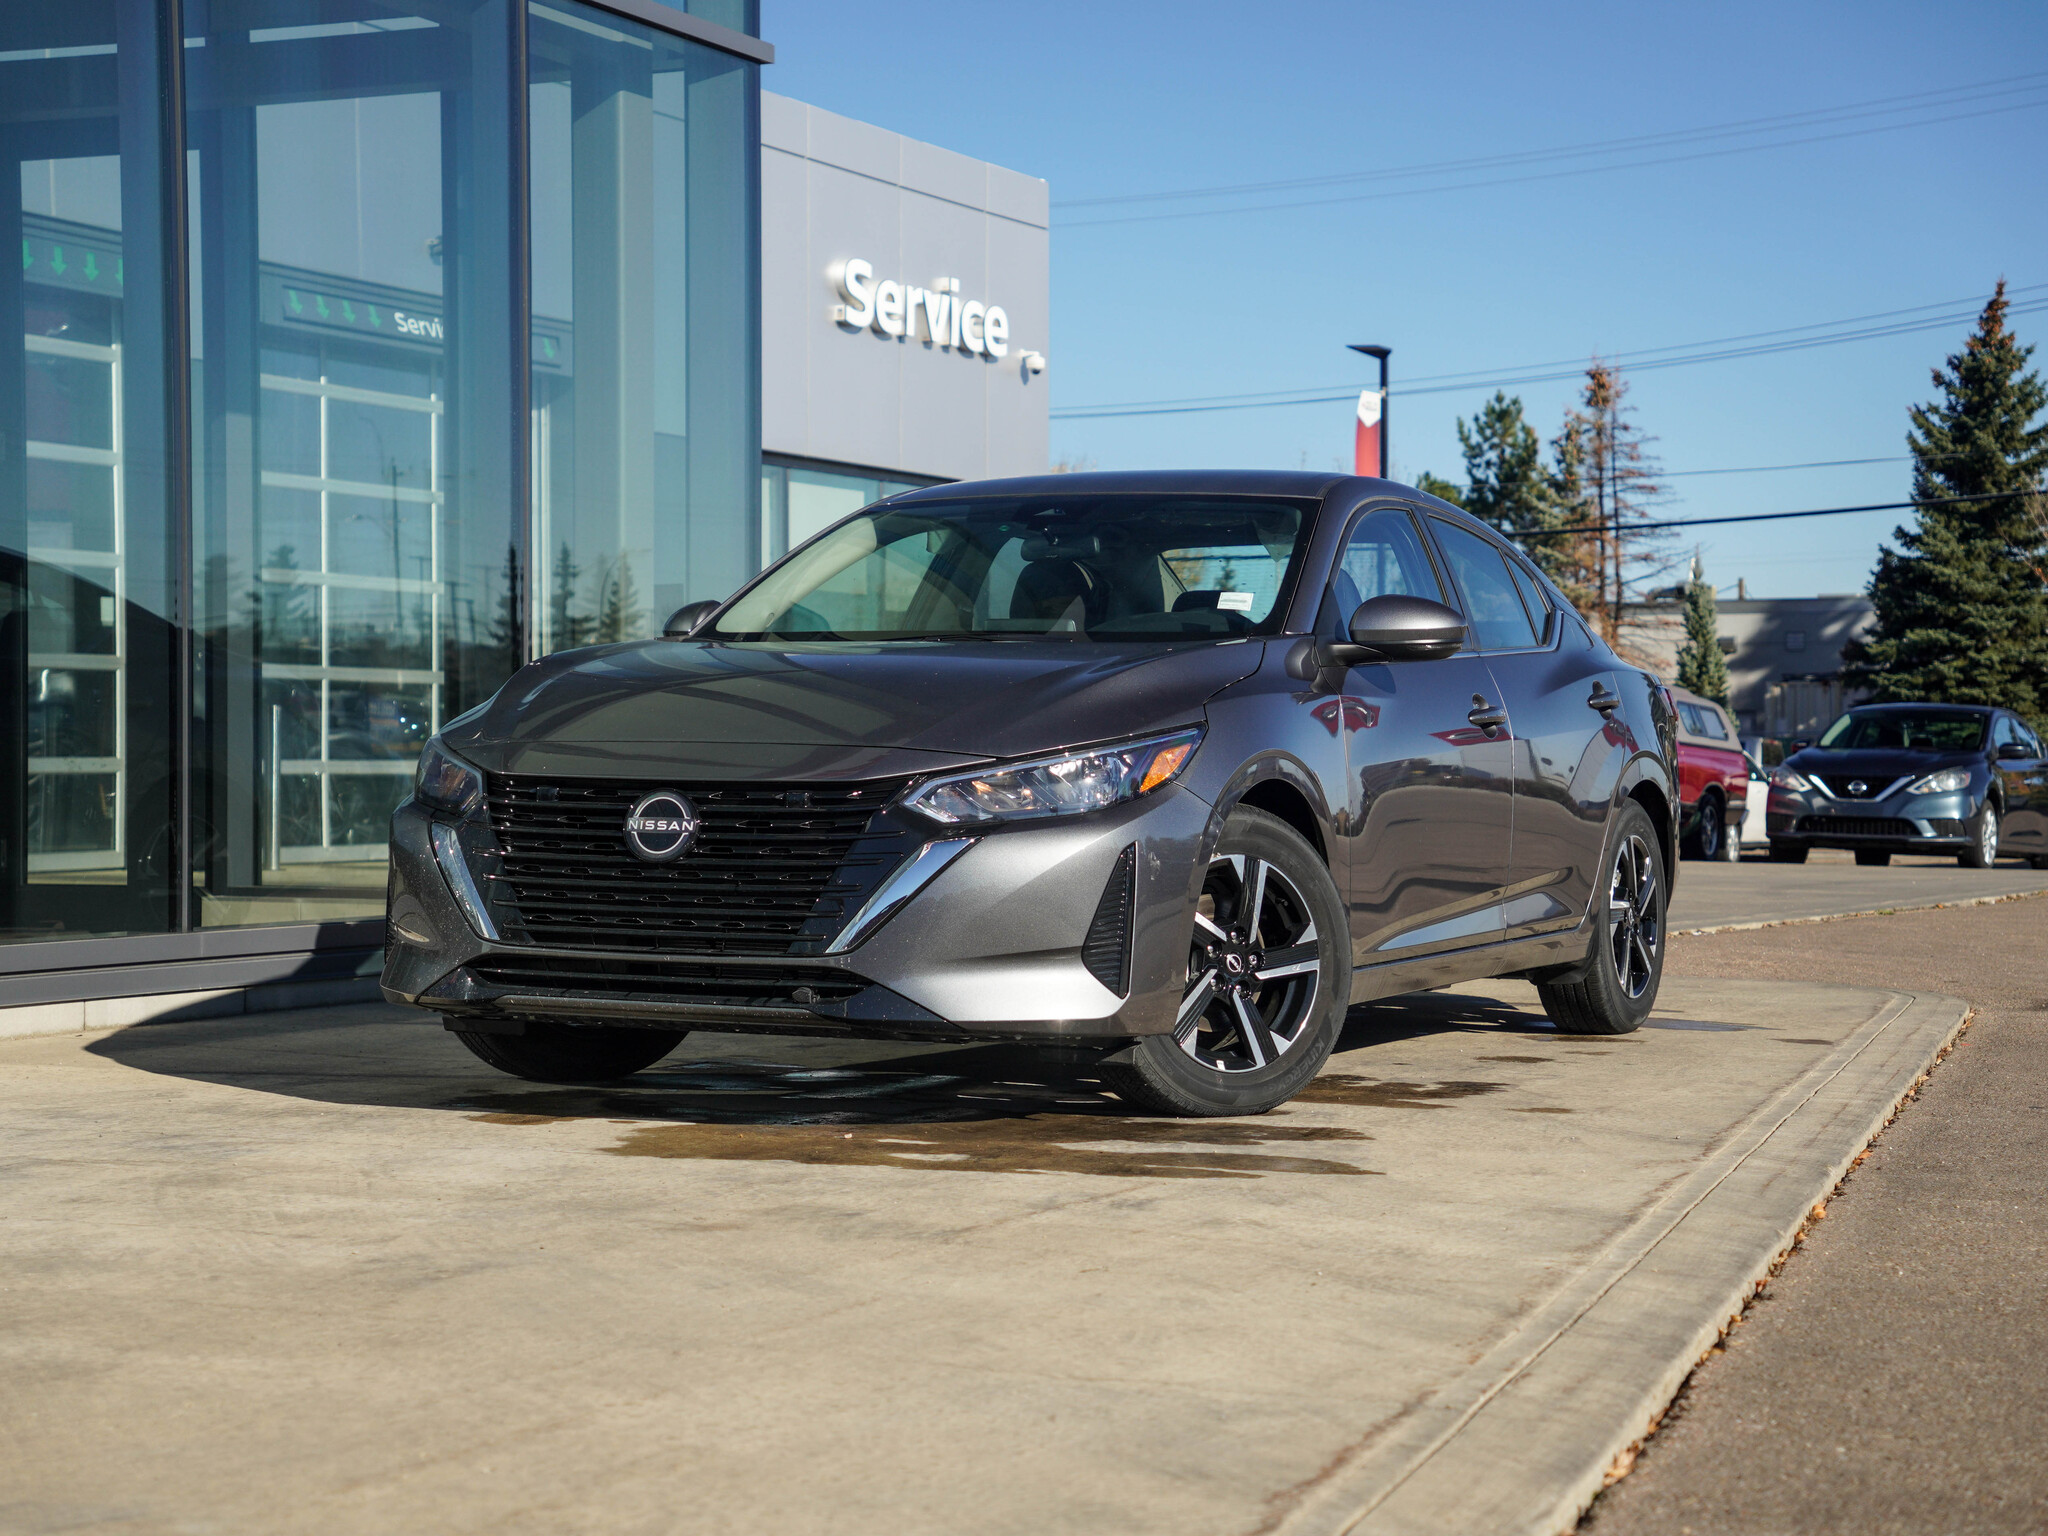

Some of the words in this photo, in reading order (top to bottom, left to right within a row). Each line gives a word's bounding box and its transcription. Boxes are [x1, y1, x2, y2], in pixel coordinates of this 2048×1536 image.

[845, 258, 1009, 358] Service
[394, 312, 444, 339] Servi
[628, 820, 694, 831] NISSAN
